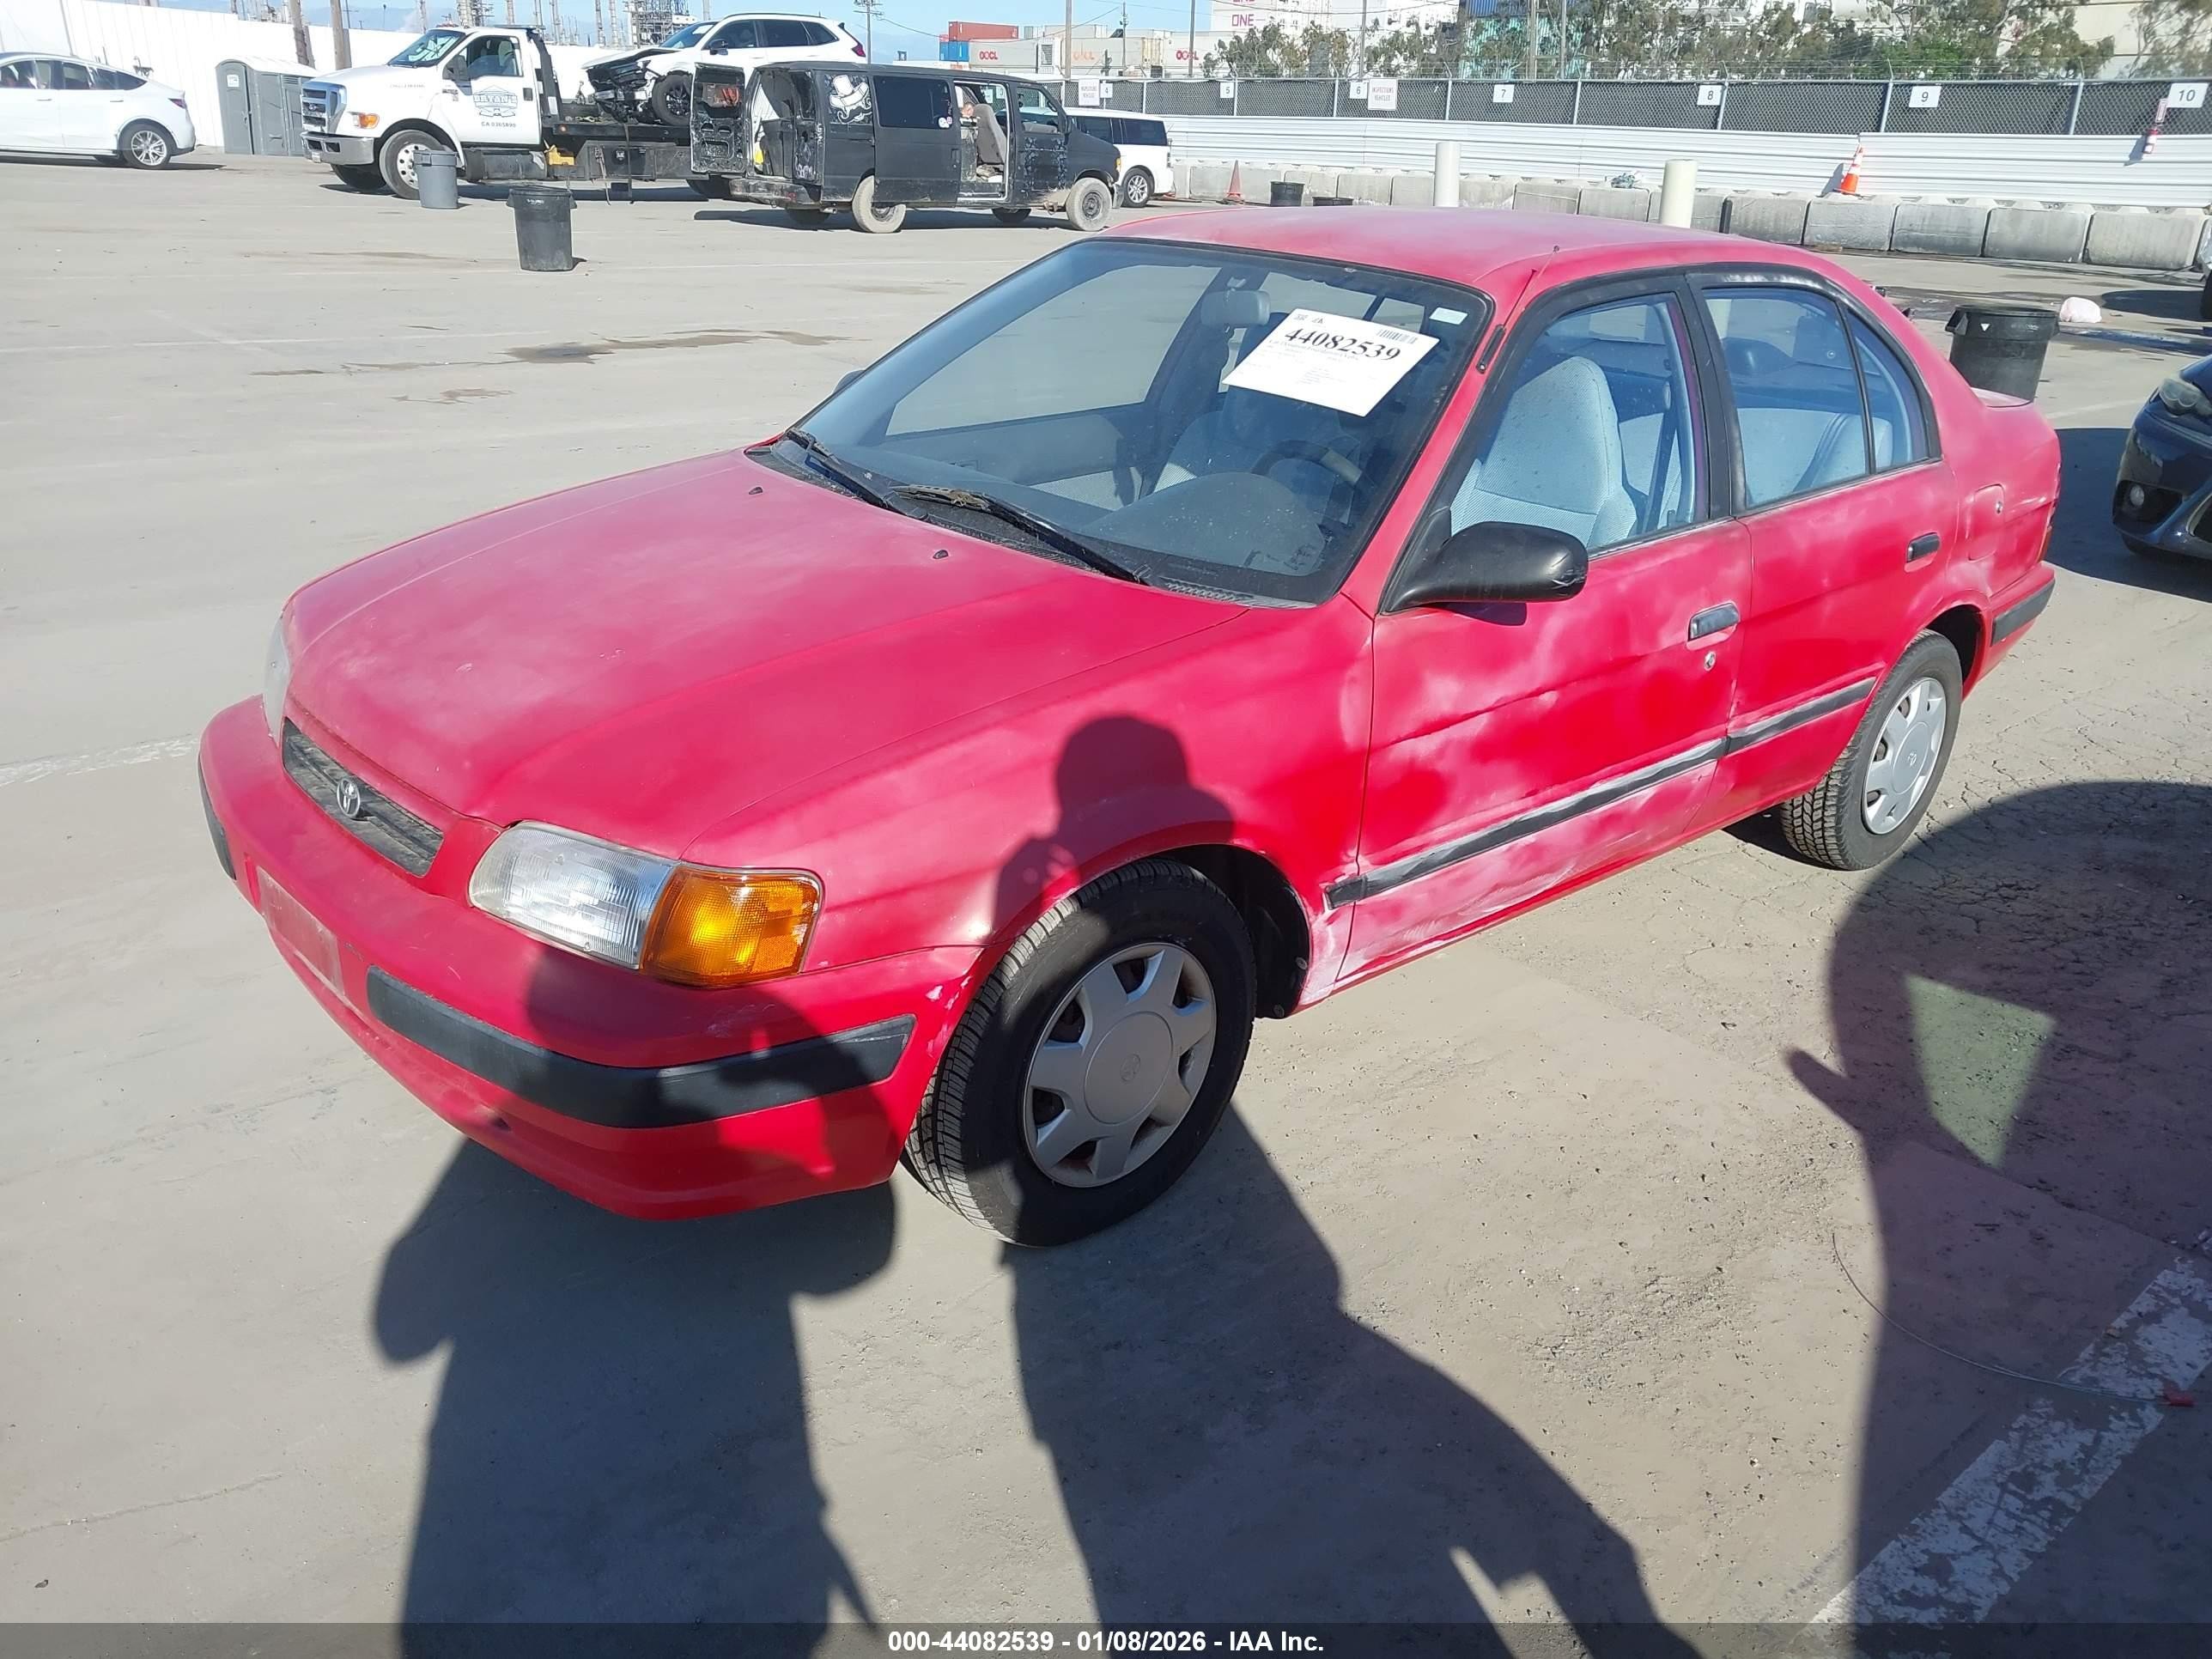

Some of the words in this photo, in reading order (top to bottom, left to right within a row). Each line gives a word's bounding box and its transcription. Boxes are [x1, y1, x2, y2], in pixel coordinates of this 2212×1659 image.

[1231, 14, 1255, 27] ONE
[979, 51, 999, 60] OOCL
[1225, 86, 1231, 94] 5
[1356, 86, 1361, 95] 6
[1501, 88, 1507, 99] 7
[1707, 90, 1714, 100] 8
[2179, 89, 2196, 102] 10
[1921, 91, 1929, 103] 9
[1285, 328, 1401, 361] 44082539
